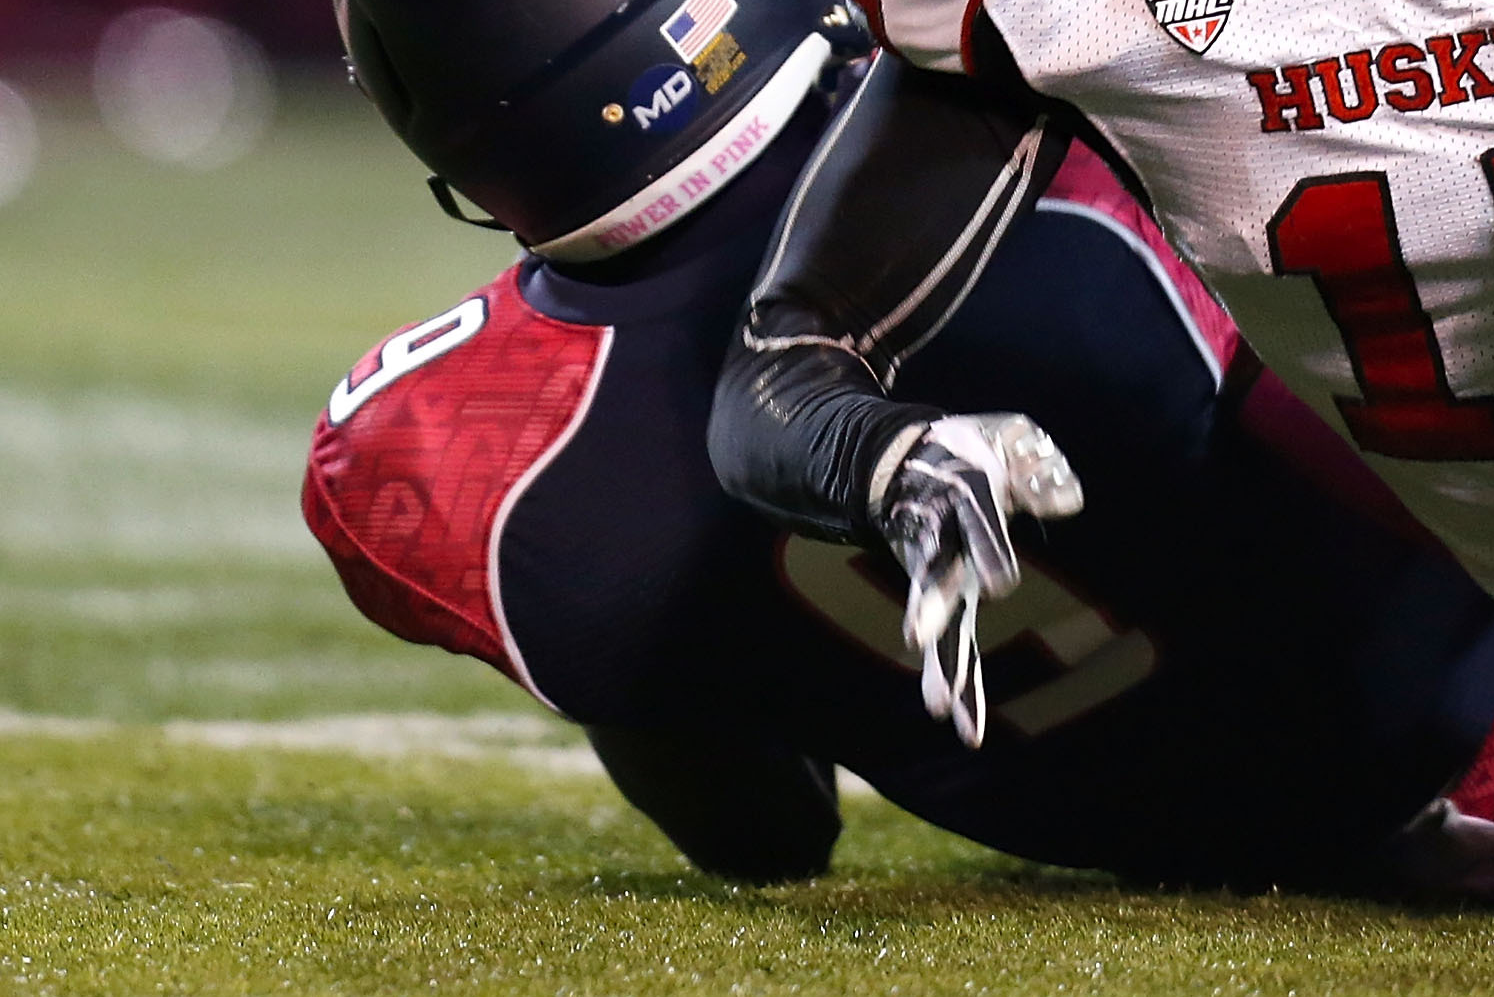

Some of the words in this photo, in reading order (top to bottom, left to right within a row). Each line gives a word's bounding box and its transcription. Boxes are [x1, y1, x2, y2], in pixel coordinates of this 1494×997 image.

[632, 70, 692, 129] MD
[679, 169, 711, 200] IN
[710, 115, 770, 175] PINK
[328, 294, 490, 427] 9
